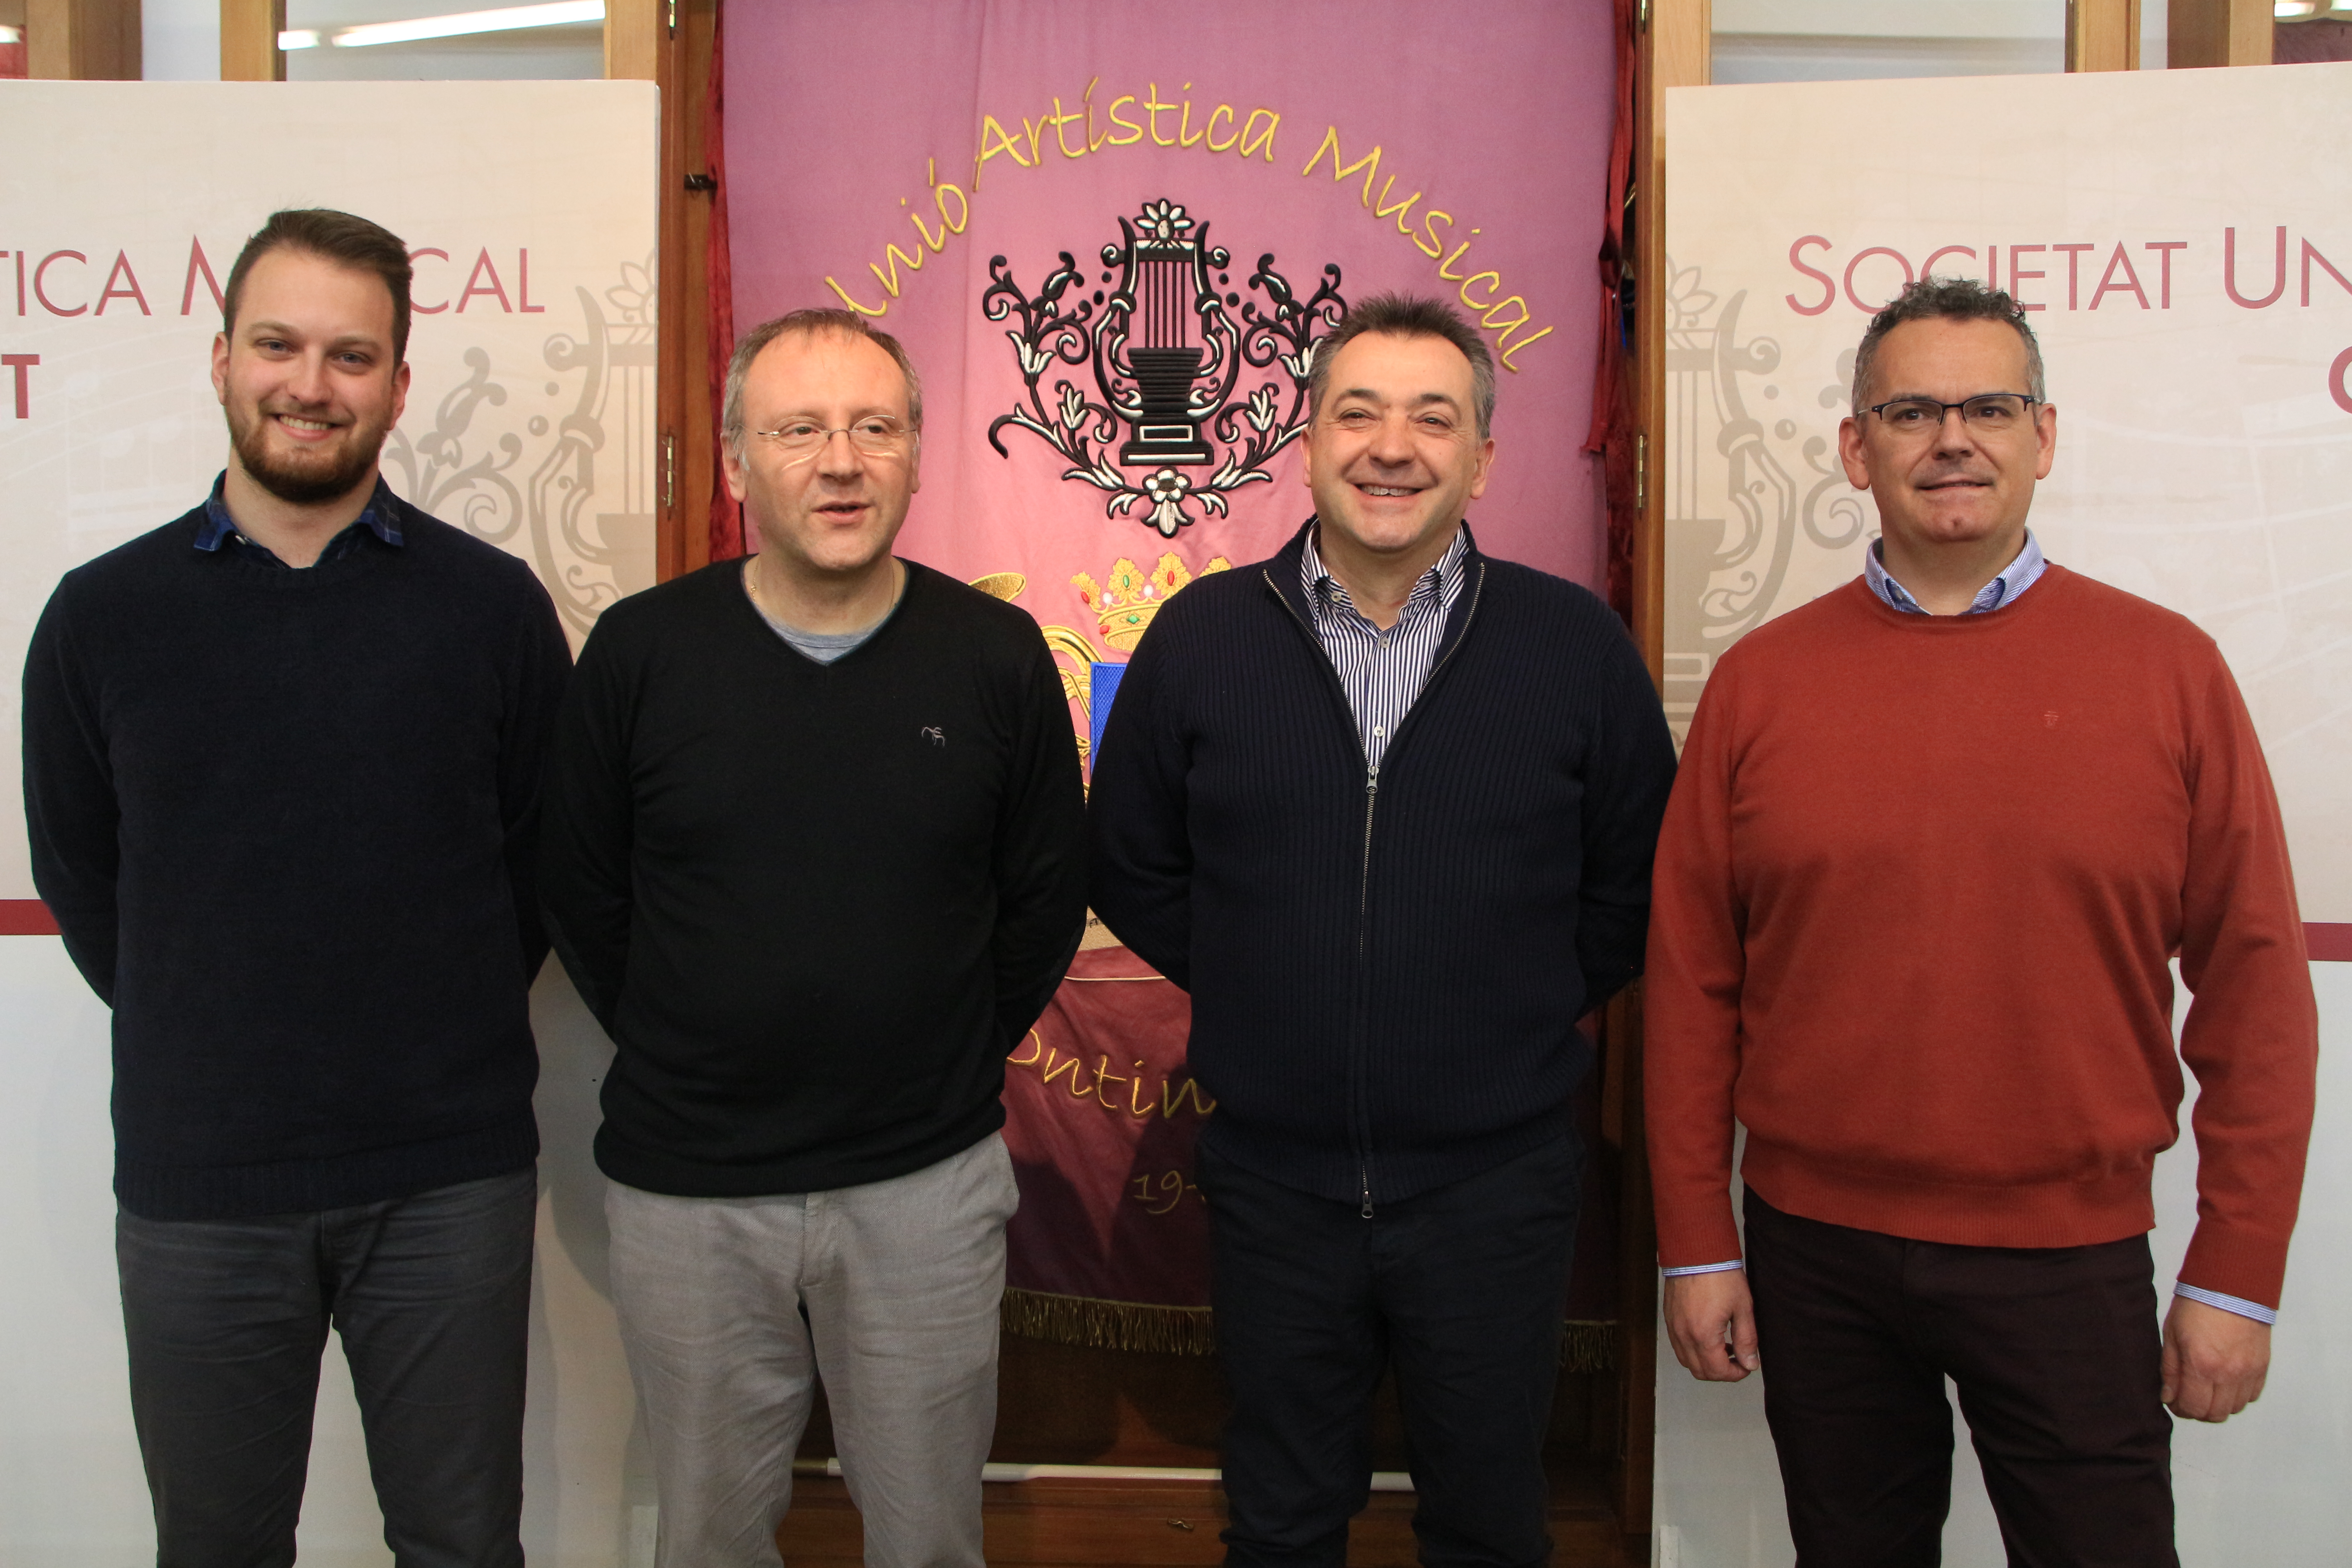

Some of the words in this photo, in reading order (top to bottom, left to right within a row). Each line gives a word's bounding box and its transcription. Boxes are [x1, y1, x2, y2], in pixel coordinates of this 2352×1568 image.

[0, 249, 152, 317] ICA
[180, 233, 545, 314] MCAL
[972, 76, 1281, 191] Artística
[1302, 126, 1554, 374] Musical
